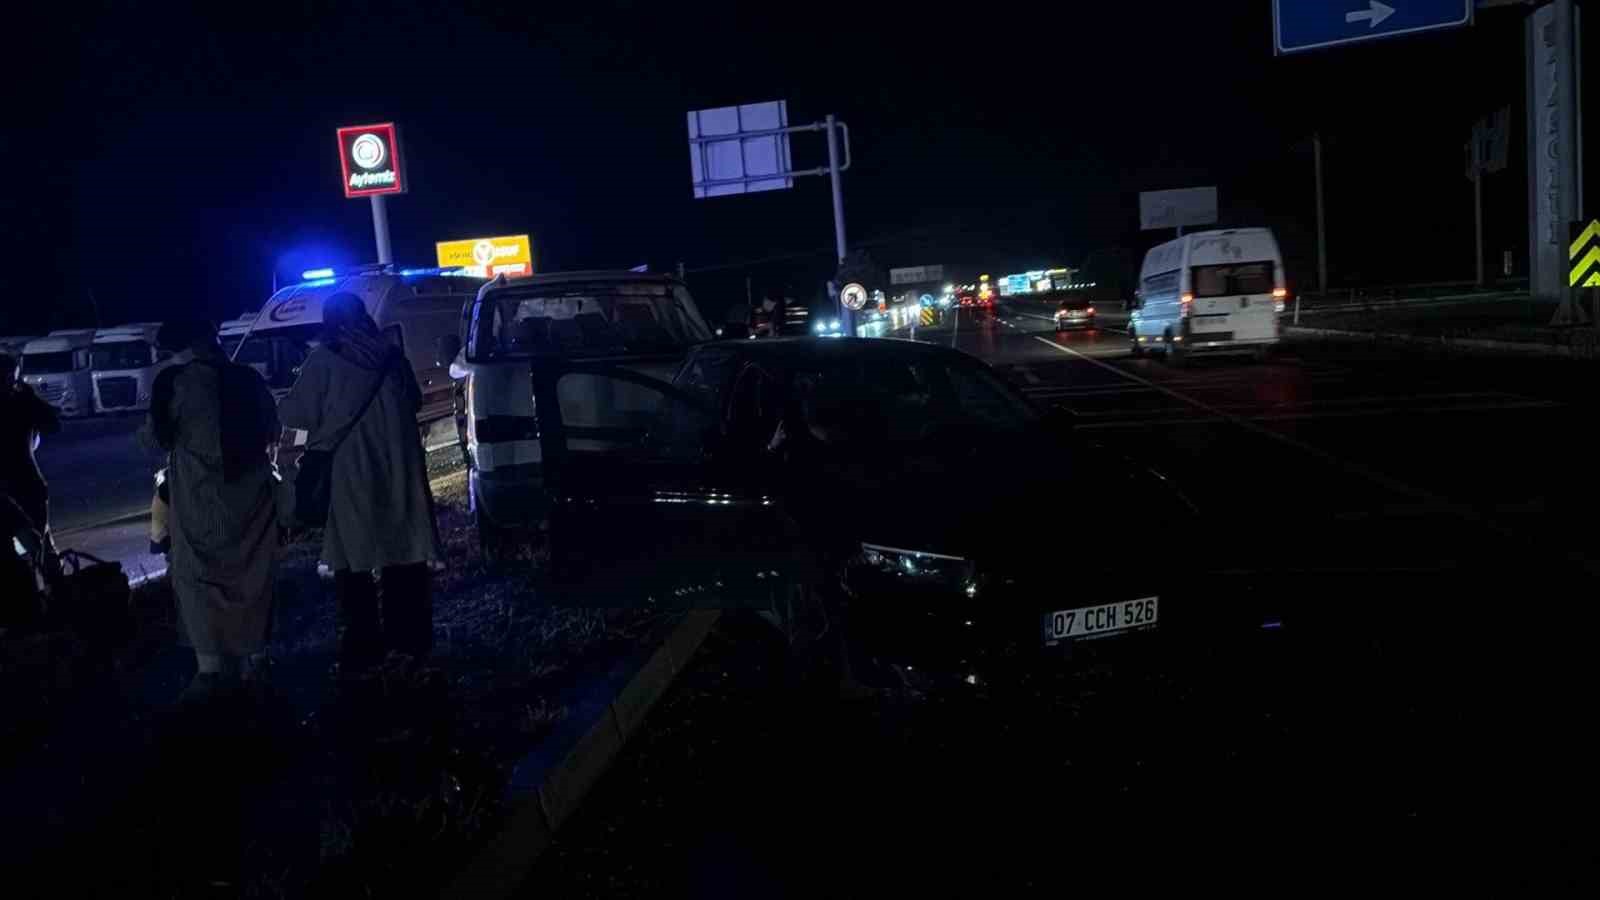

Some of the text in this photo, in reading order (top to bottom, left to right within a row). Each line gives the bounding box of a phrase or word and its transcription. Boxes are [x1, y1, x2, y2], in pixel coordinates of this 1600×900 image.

[1054, 600, 1155, 635] 07 CCH 526
